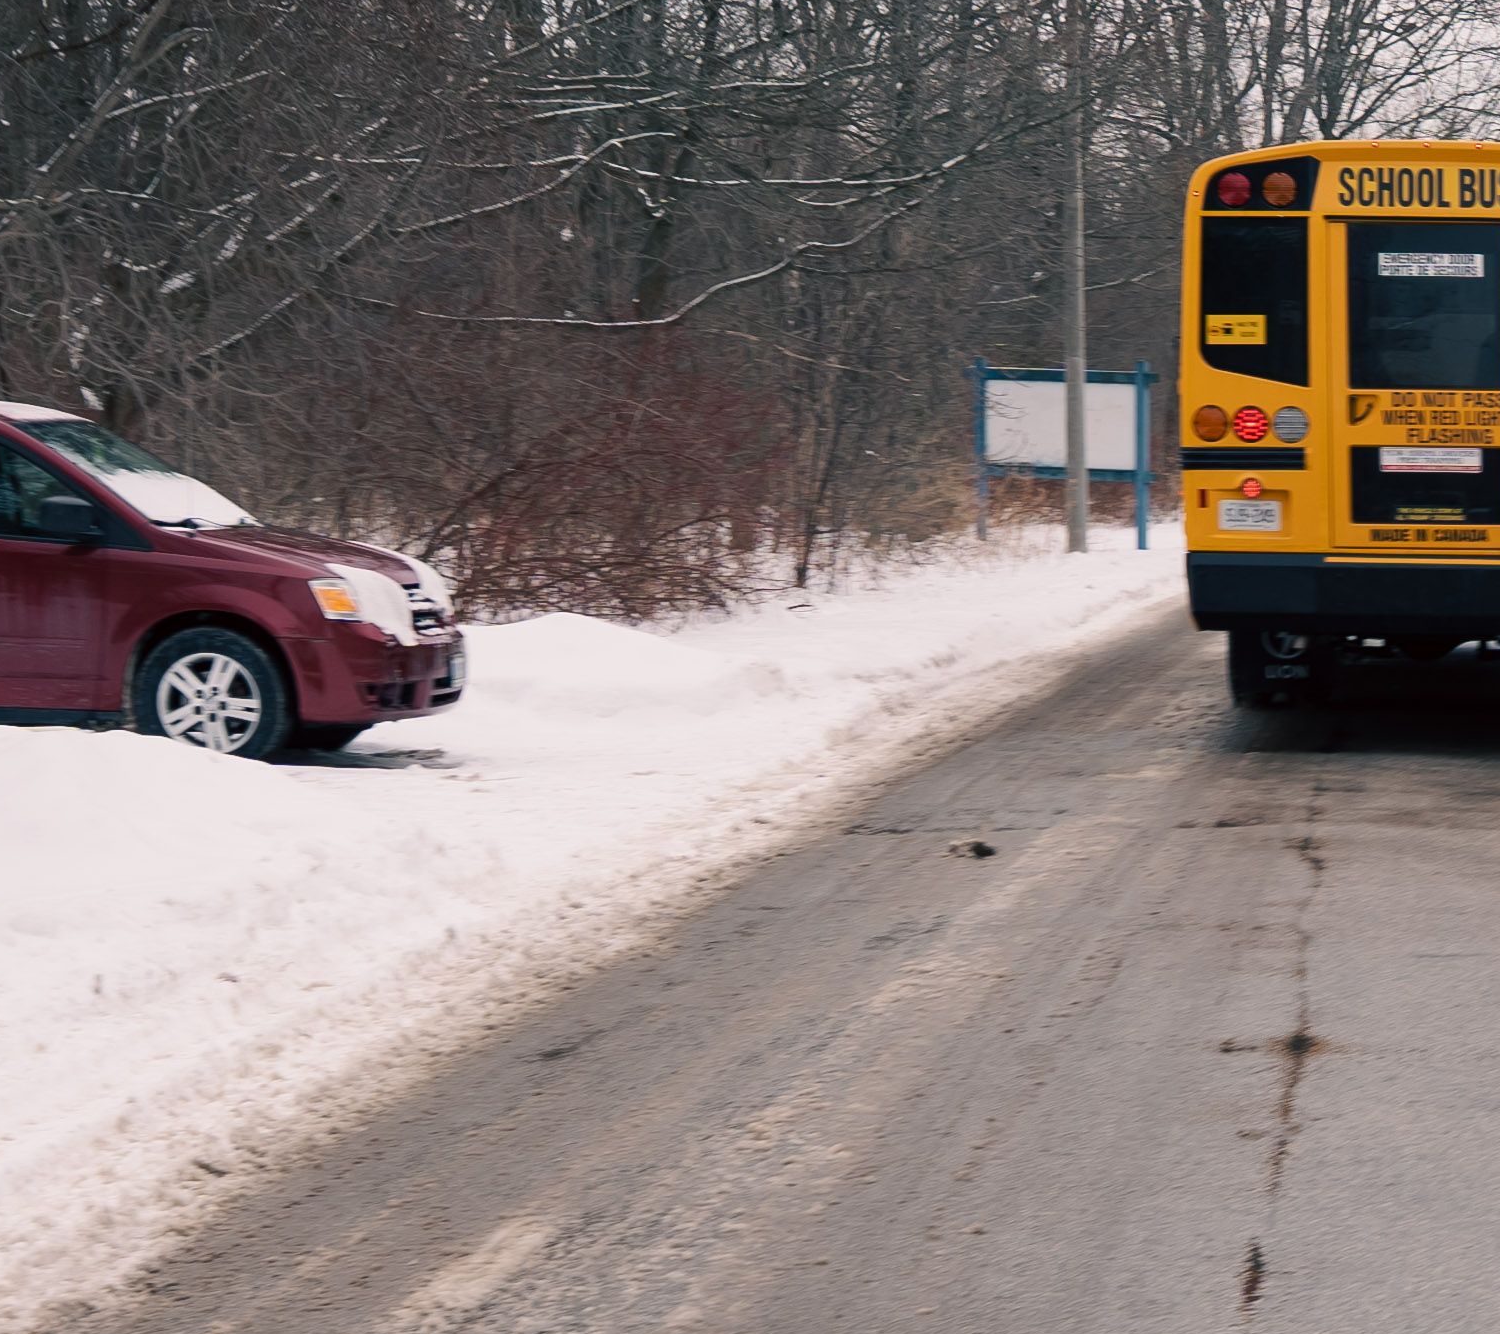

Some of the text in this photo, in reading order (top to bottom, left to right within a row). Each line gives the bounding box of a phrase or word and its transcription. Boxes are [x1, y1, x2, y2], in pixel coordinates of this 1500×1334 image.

[1338, 167, 1451, 207] SCHOOL
[1383, 254, 1475, 264] EMERGENCY DOOR
[1380, 265, 1478, 276] PORTE DE SECOURS
[1391, 392, 1417, 407] DO
[1421, 392, 1456, 407] NOT
[1383, 410, 1427, 425] WHEN
[1430, 410, 1461, 425] RED
[1407, 428, 1494, 444] FLASHING
[1370, 529, 1489, 542] MADE IN CANADA
